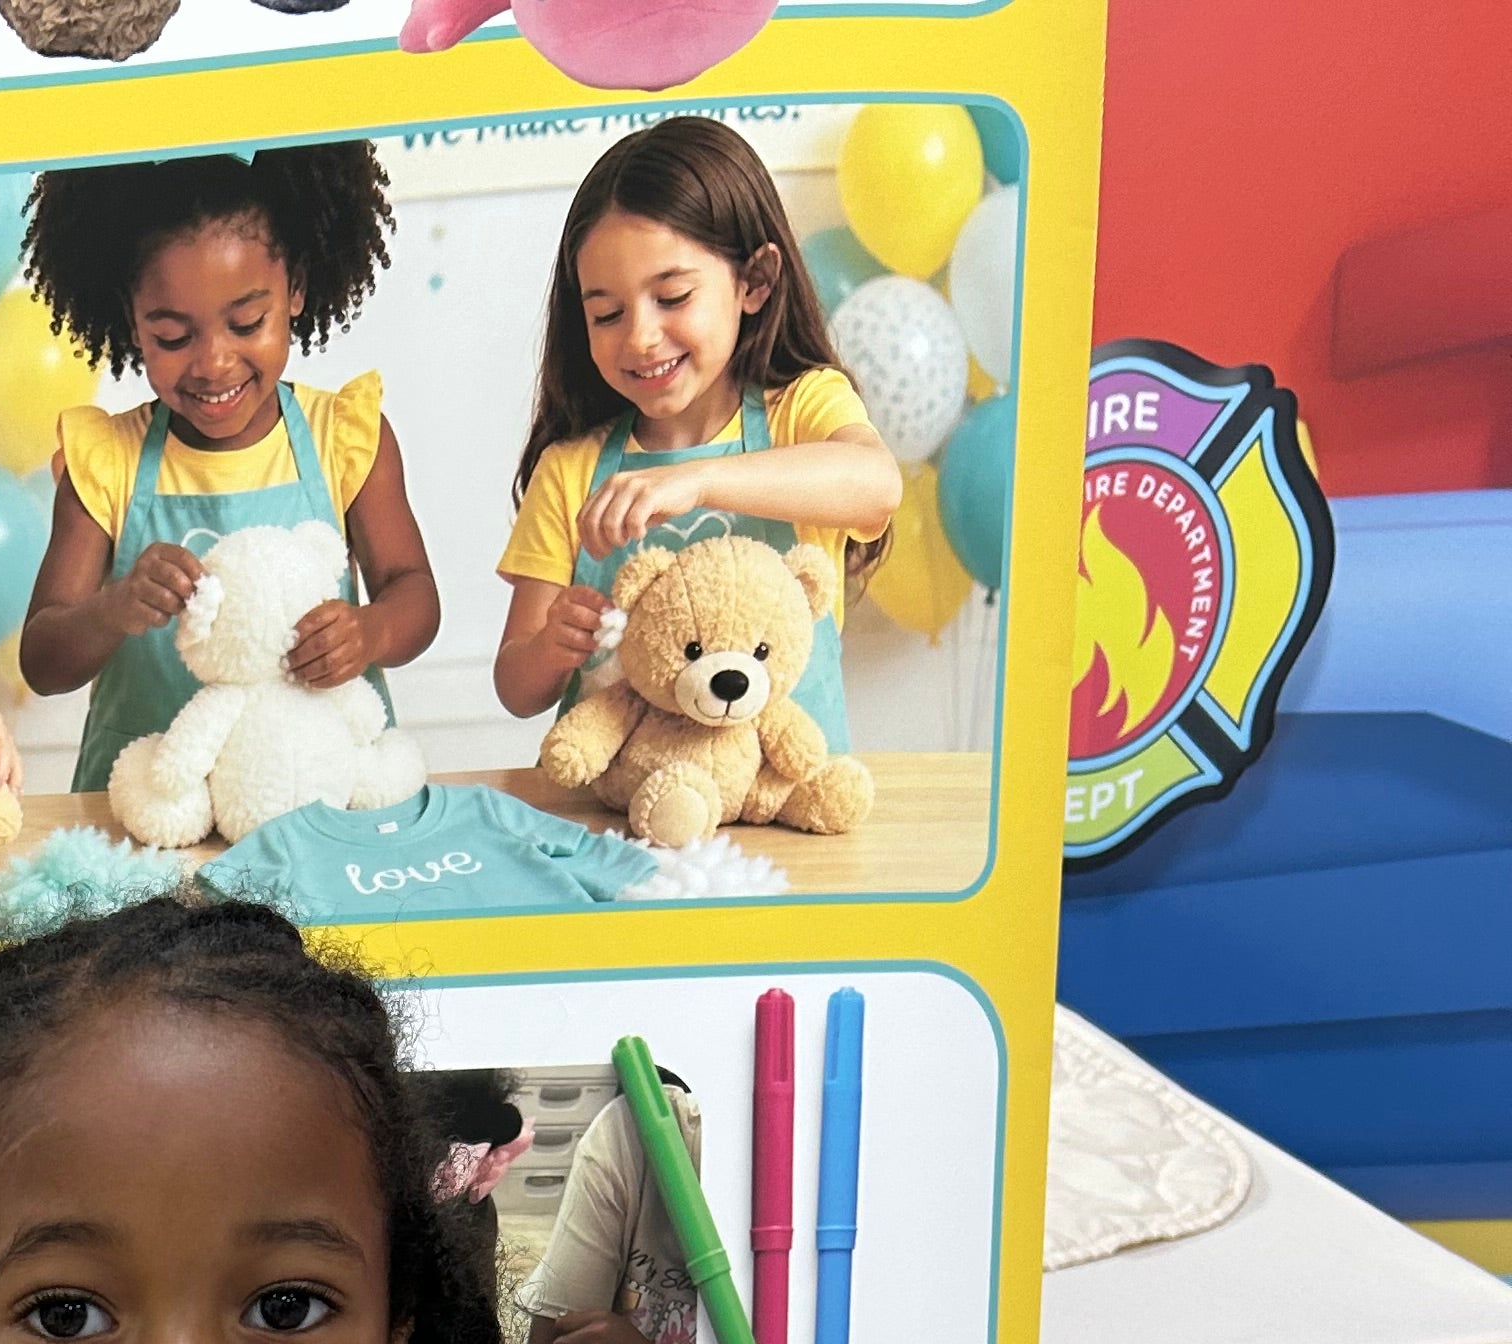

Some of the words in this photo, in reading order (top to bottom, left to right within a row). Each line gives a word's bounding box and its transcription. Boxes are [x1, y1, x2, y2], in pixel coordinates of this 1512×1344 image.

[1088, 391, 1160, 438] IRE
[1085, 471, 1130, 502] IRE
[1136, 473, 1213, 663] DEPARTMENT
[1064, 768, 1144, 822] EPT
[345, 851, 483, 895] love
